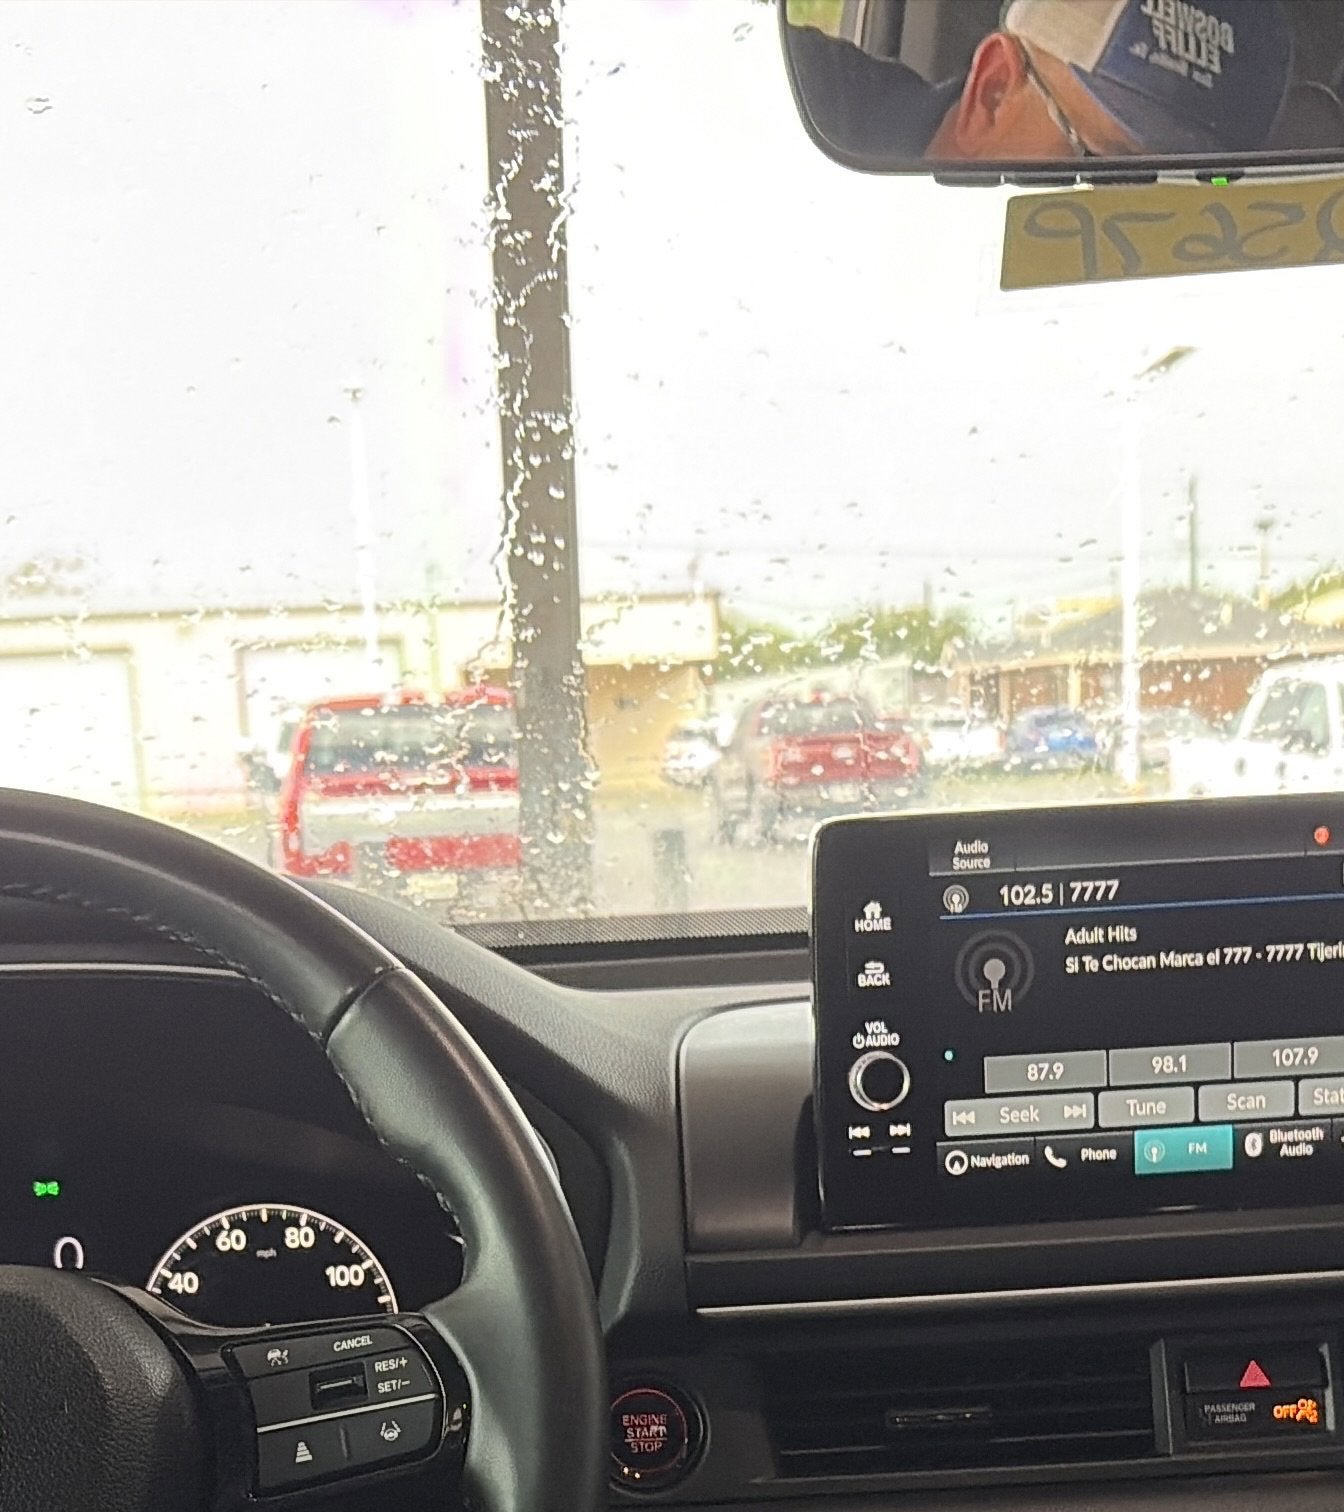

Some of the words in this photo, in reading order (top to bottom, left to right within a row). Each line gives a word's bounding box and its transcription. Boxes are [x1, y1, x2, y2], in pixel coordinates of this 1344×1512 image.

[954, 840, 989, 855] Audio
[952, 857, 991, 870] Source
[1000, 883, 1054, 906] 102.5
[1069, 879, 1120, 903] 7777
[854, 918, 892, 932] HOME
[1064, 926, 1105, 945] Adult
[1107, 924, 1137, 942] Hits
[1081, 955, 1099, 972] Te
[1102, 952, 1156, 972] Chocan
[1159, 950, 1203, 969] Marca
[1206, 948, 1221, 965] el
[1223, 946, 1252, 964] 777
[1265, 944, 1304, 963] 7777
[858, 973, 891, 987] BACK
[978, 989, 1012, 1012] FM
[864, 1021, 888, 1034] VOL
[866, 1032, 900, 1047] AUDIO
[1151, 1054, 1187, 1074] 98.1
[1272, 1047, 1319, 1067] 107.9
[1027, 1062, 1064, 1081] 87.9
[1126, 1099, 1167, 1117] Tune
[1227, 1093, 1266, 1110] Scan
[999, 1105, 1040, 1123] Seek
[1269, 1126, 1324, 1143] Bluetooth
[1081, 1147, 1117, 1161] Phone
[1188, 1142, 1208, 1154] FM
[1279, 1143, 1313, 1157] Audio
[970, 1152, 1029, 1169] Navigation
[214, 1228, 248, 1252] 60
[283, 1226, 316, 1249] 80
[166, 1271, 200, 1295] 40
[324, 1264, 366, 1288] 100
[333, 1335, 374, 1352] CANCEL
[374, 1356, 409, 1373] RES/+
[1203, 1401, 1256, 1415] PASSENGER
[1272, 1403, 1297, 1419] OFF
[622, 1412, 668, 1427] ENGINE
[1214, 1413, 1247, 1425] AIRBAG
[626, 1425, 668, 1438] START
[630, 1441, 663, 1454] STOP
